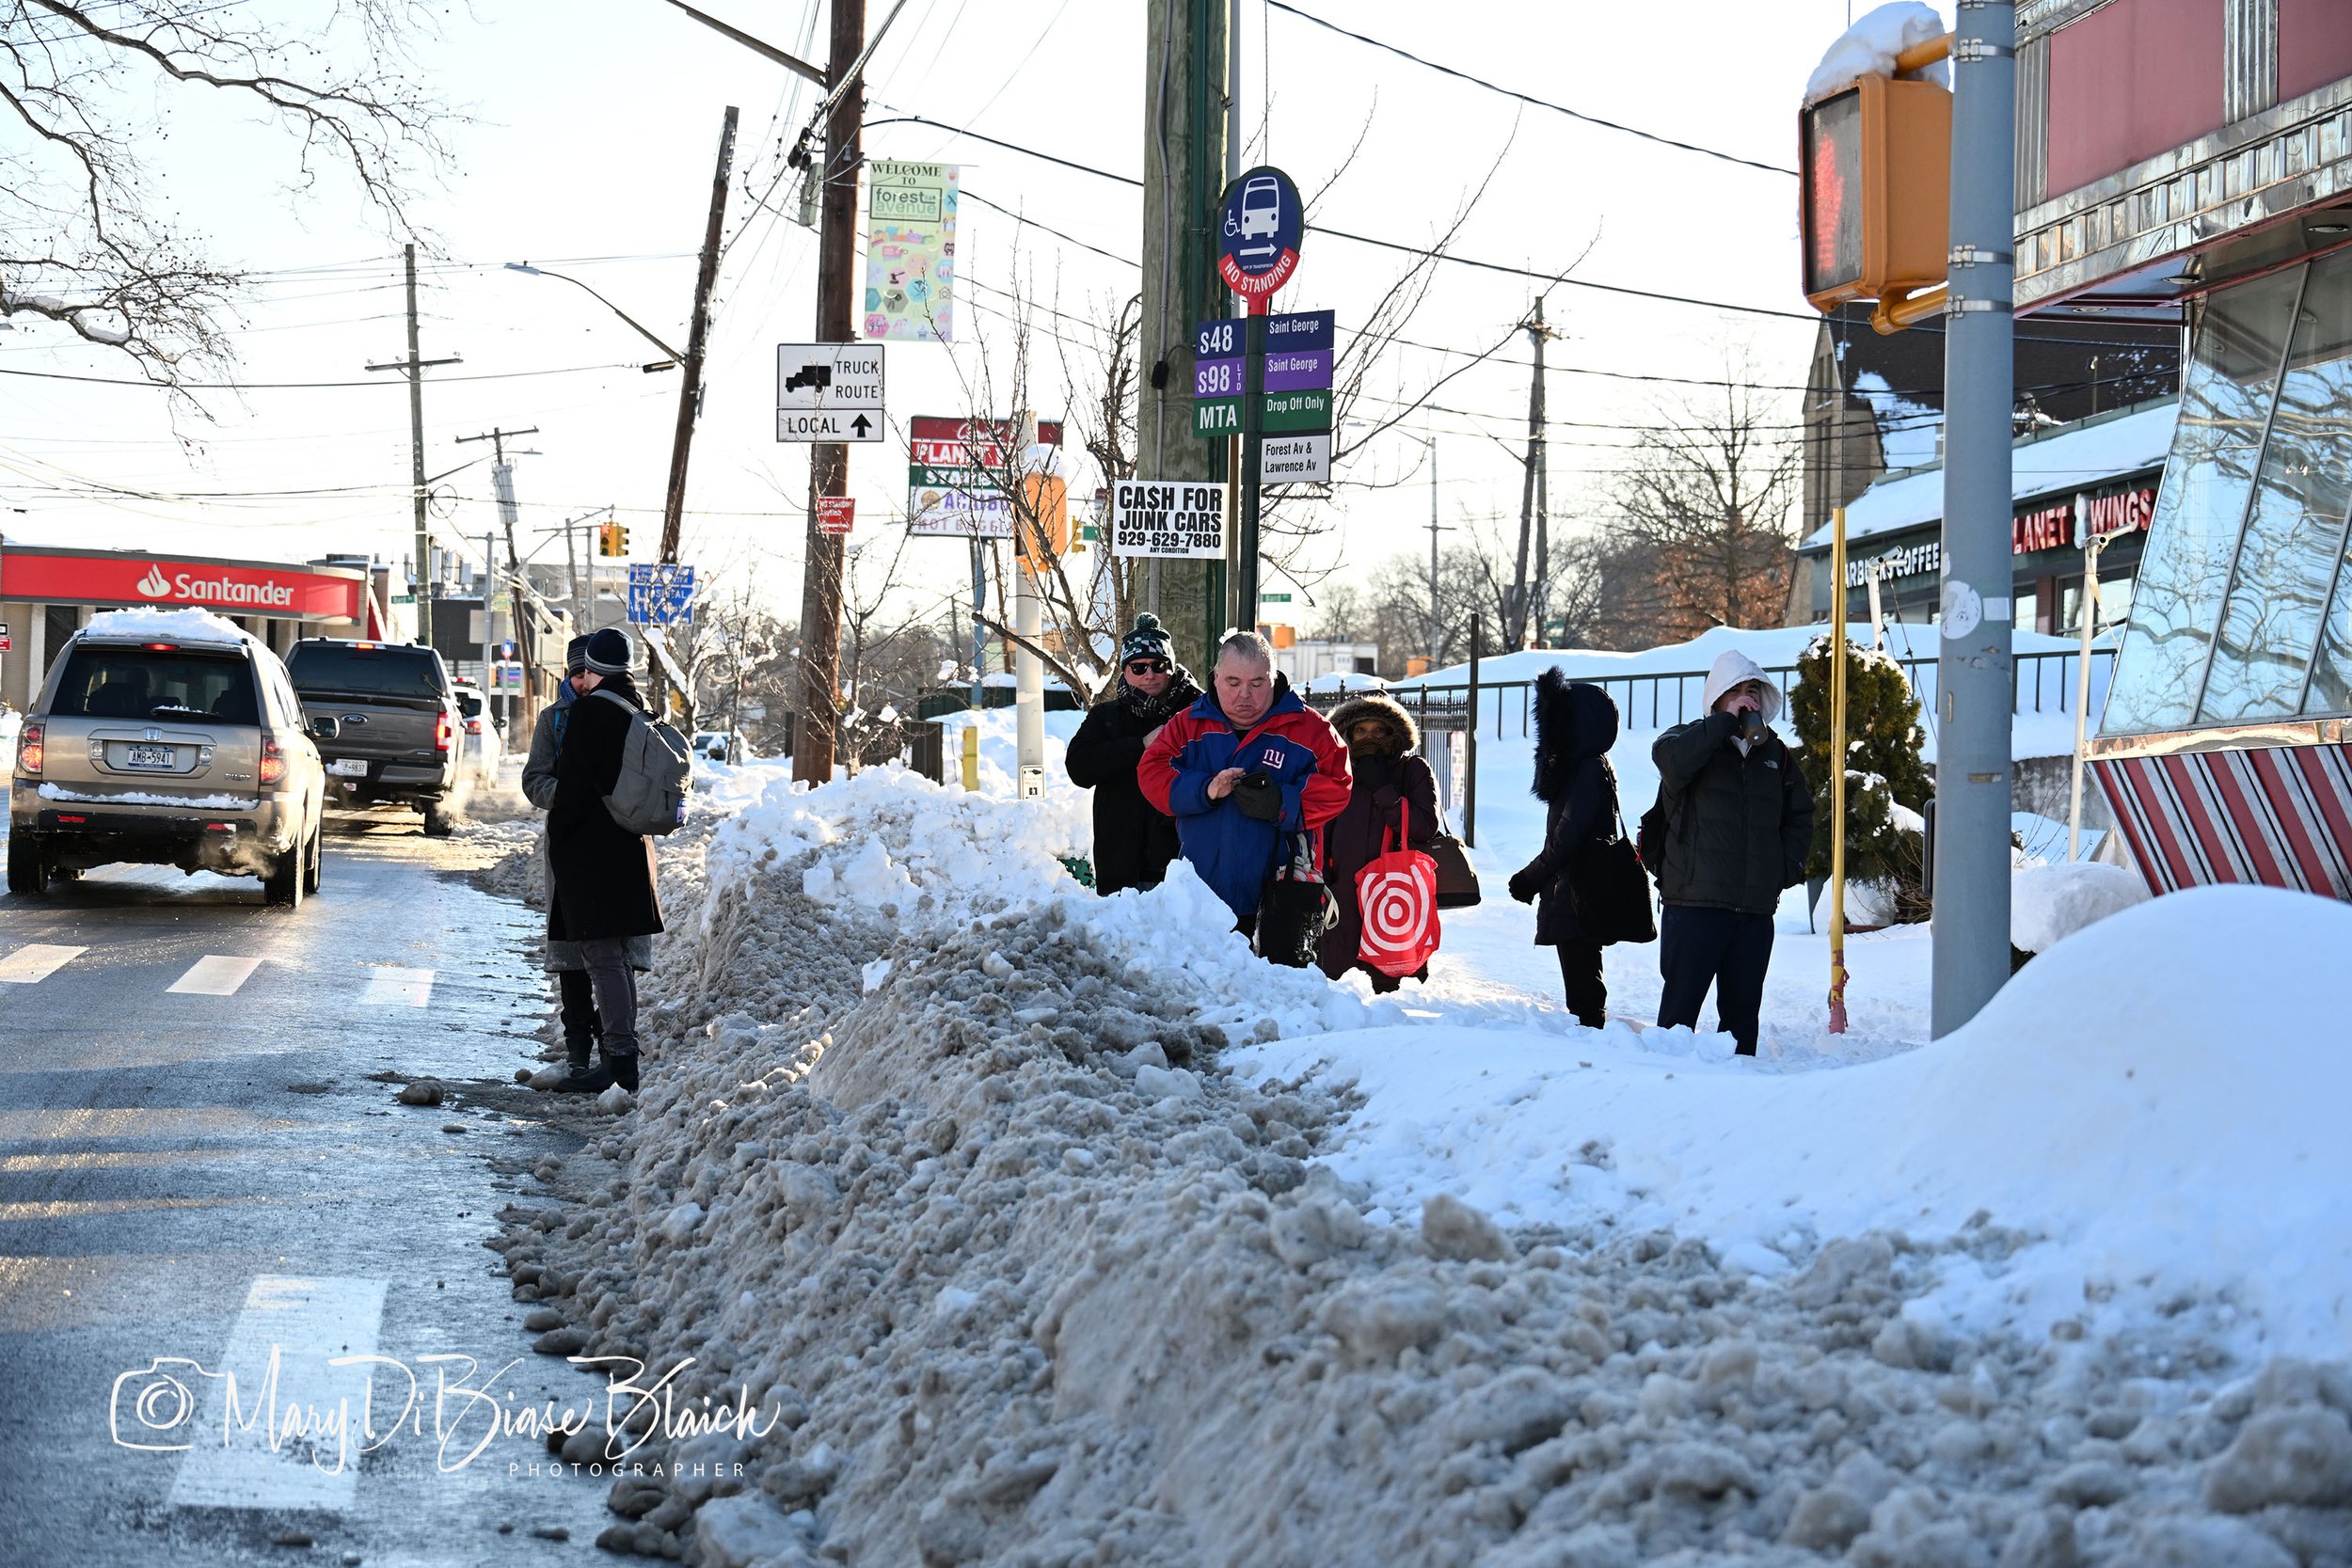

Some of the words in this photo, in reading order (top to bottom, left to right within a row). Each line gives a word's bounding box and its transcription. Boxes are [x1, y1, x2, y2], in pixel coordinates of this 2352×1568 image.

[871, 164, 941, 177] WELCOME
[902, 177, 916, 185] TO
[876, 188, 928, 204] forest
[875, 201, 937, 214] avenue
[1224, 261, 1241, 283] NO
[1240, 254, 1292, 293] STANDING
[1269, 320, 1290, 335] Saint
[1292, 319, 1319, 334] George
[1200, 325, 1233, 355] S48
[835, 361, 879, 374] TRUCK
[1268, 358, 1289, 372] Saint
[1290, 357, 1318, 373] George
[1198, 364, 1231, 394] S98
[835, 386, 879, 399] ROUTE
[1266, 399, 1288, 414] Drop
[1290, 397, 1303, 411] Off
[1305, 396, 1325, 411] Only
[1199, 404, 1237, 430] MTA
[787, 418, 841, 434] LOCAL
[1265, 442, 1292, 456] Forest
[1293, 442, 1304, 454] Av
[1305, 442, 1312, 454] &
[1264, 460, 1304, 473] Lawrence
[1306, 459, 1317, 471] Av
[1119, 485, 1175, 512] CA$H
[1183, 487, 1223, 512] FOR
[1119, 510, 1168, 531] JUNK
[1174, 512, 1222, 533] CARS
[2011, 505, 2068, 555] LANET
[2090, 488, 2155, 534] WINGS
[1118, 531, 1221, 548] 929-629-7880
[174, 573, 294, 606] Santander
[132, 752, 169, 764] AMB-5941
